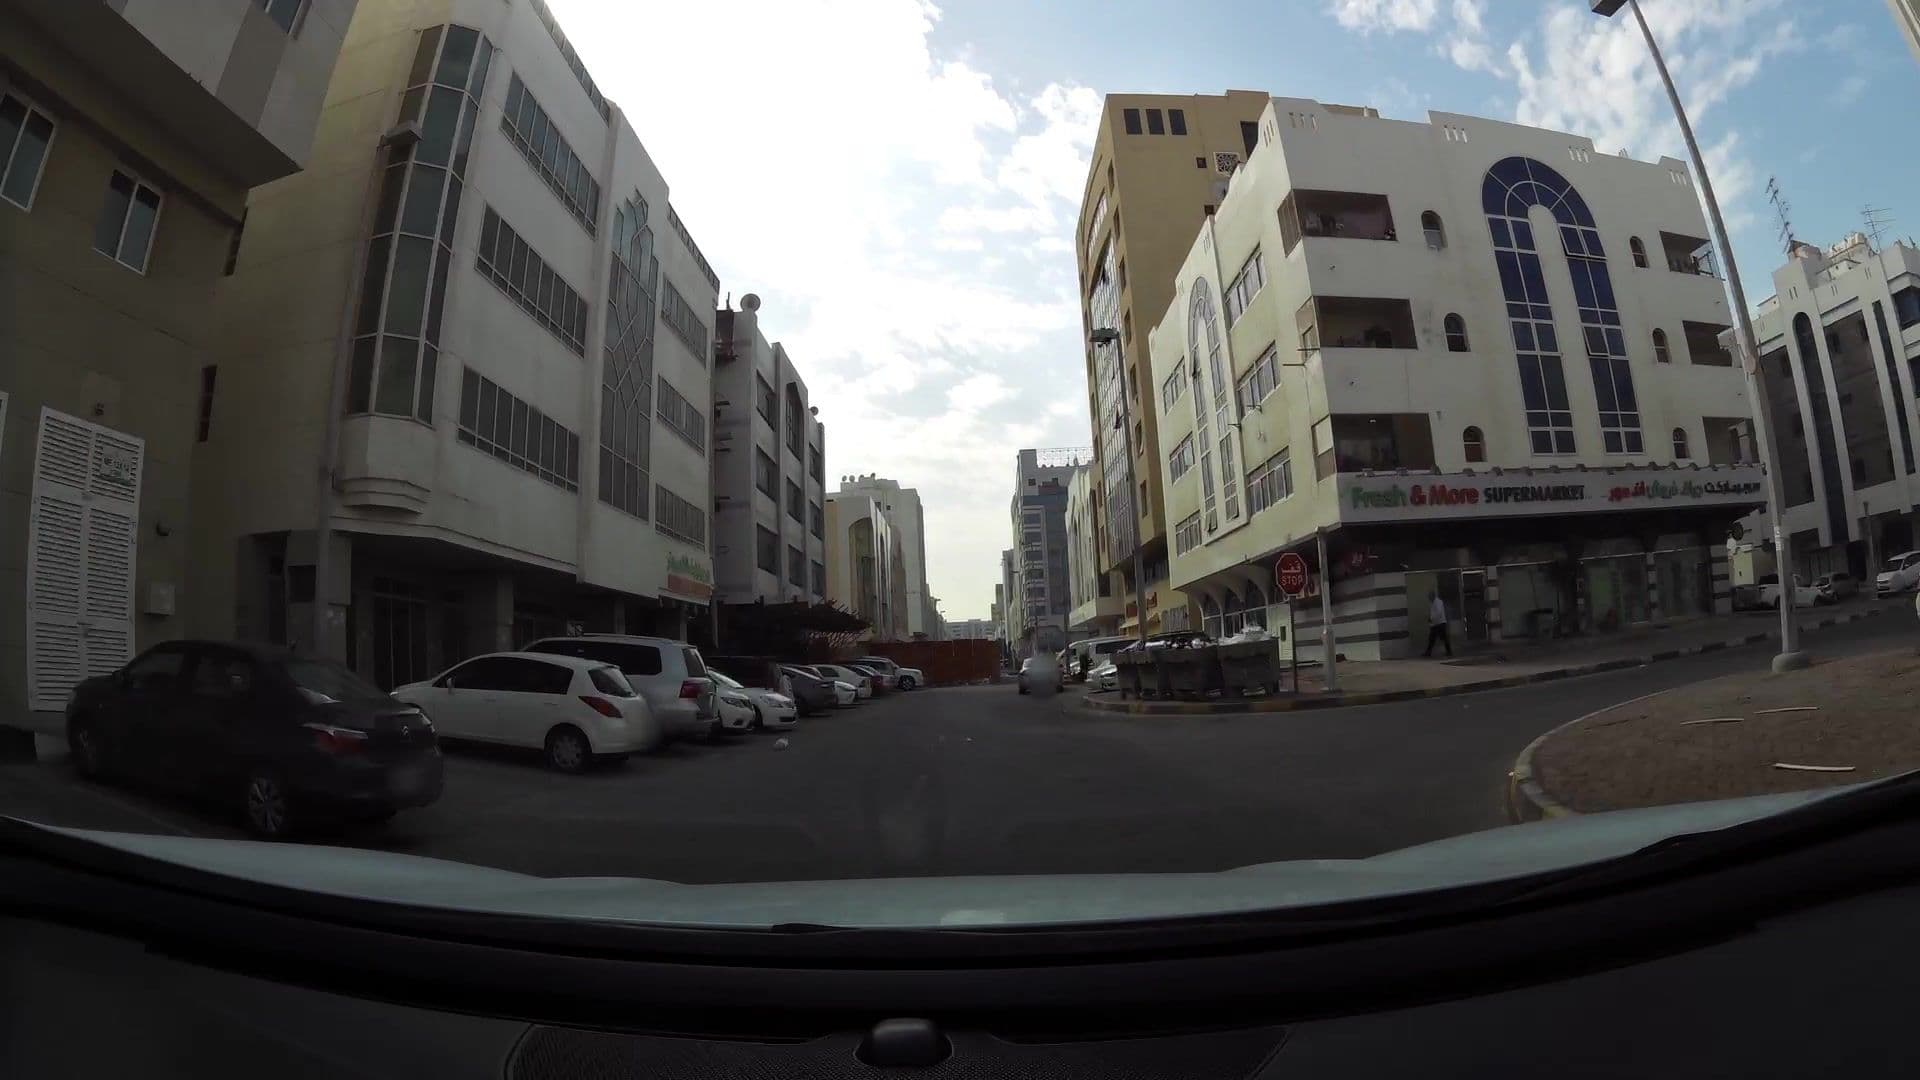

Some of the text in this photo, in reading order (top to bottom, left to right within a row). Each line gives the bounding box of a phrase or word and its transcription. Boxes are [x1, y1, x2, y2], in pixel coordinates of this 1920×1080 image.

[1351, 485, 1585, 508] Fresh & More SUPERMARKET
[1281, 560, 1302, 573] قف
[1281, 575, 1303, 586] STOP
